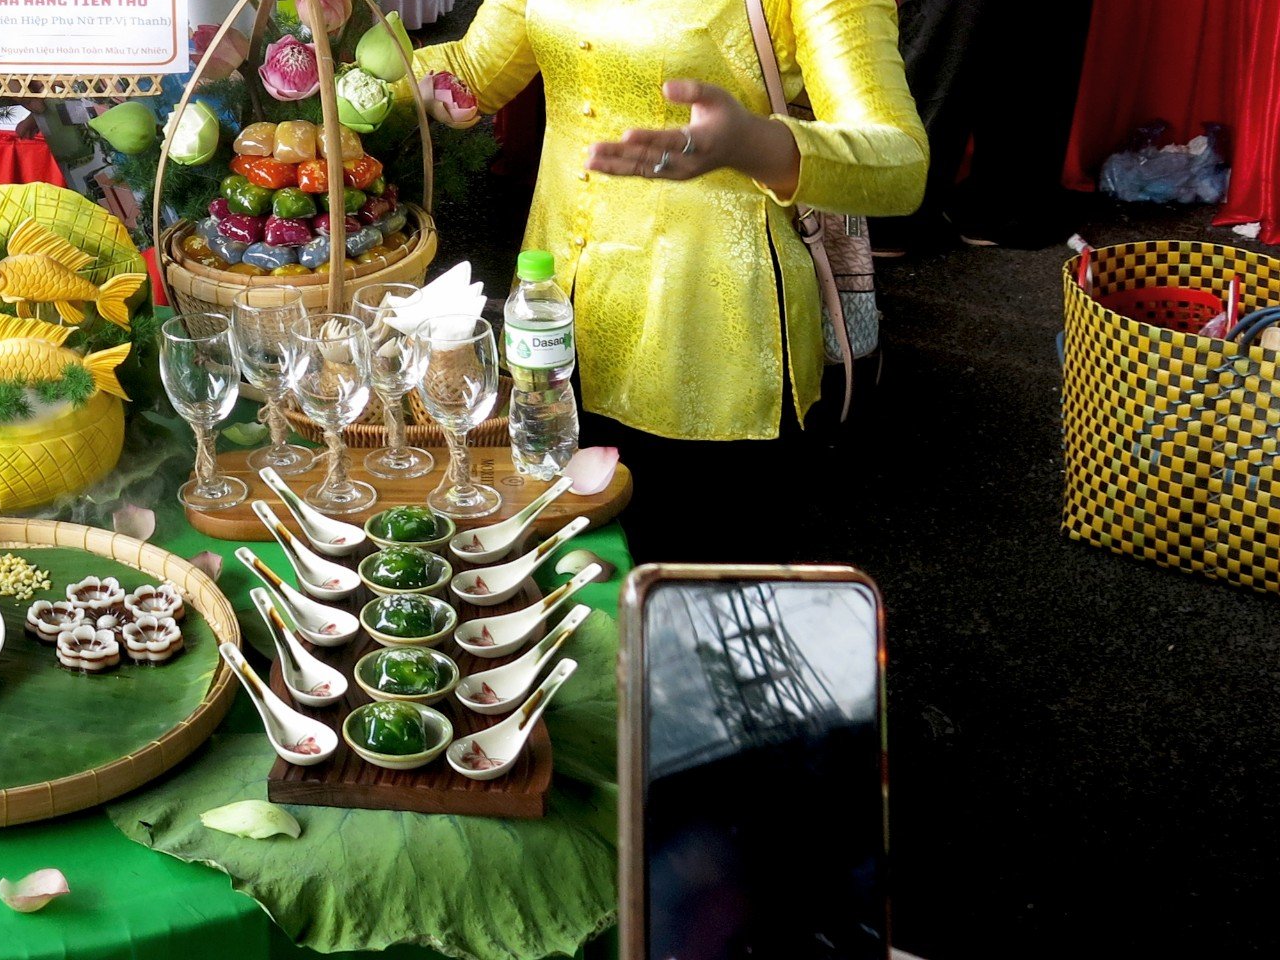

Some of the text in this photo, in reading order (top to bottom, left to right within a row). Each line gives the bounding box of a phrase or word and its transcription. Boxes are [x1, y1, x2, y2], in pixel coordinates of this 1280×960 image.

[21, 15, 48, 27] Hiệp
[51, 15, 74, 27] Phụ
[532, 336, 565, 348] Dasan
